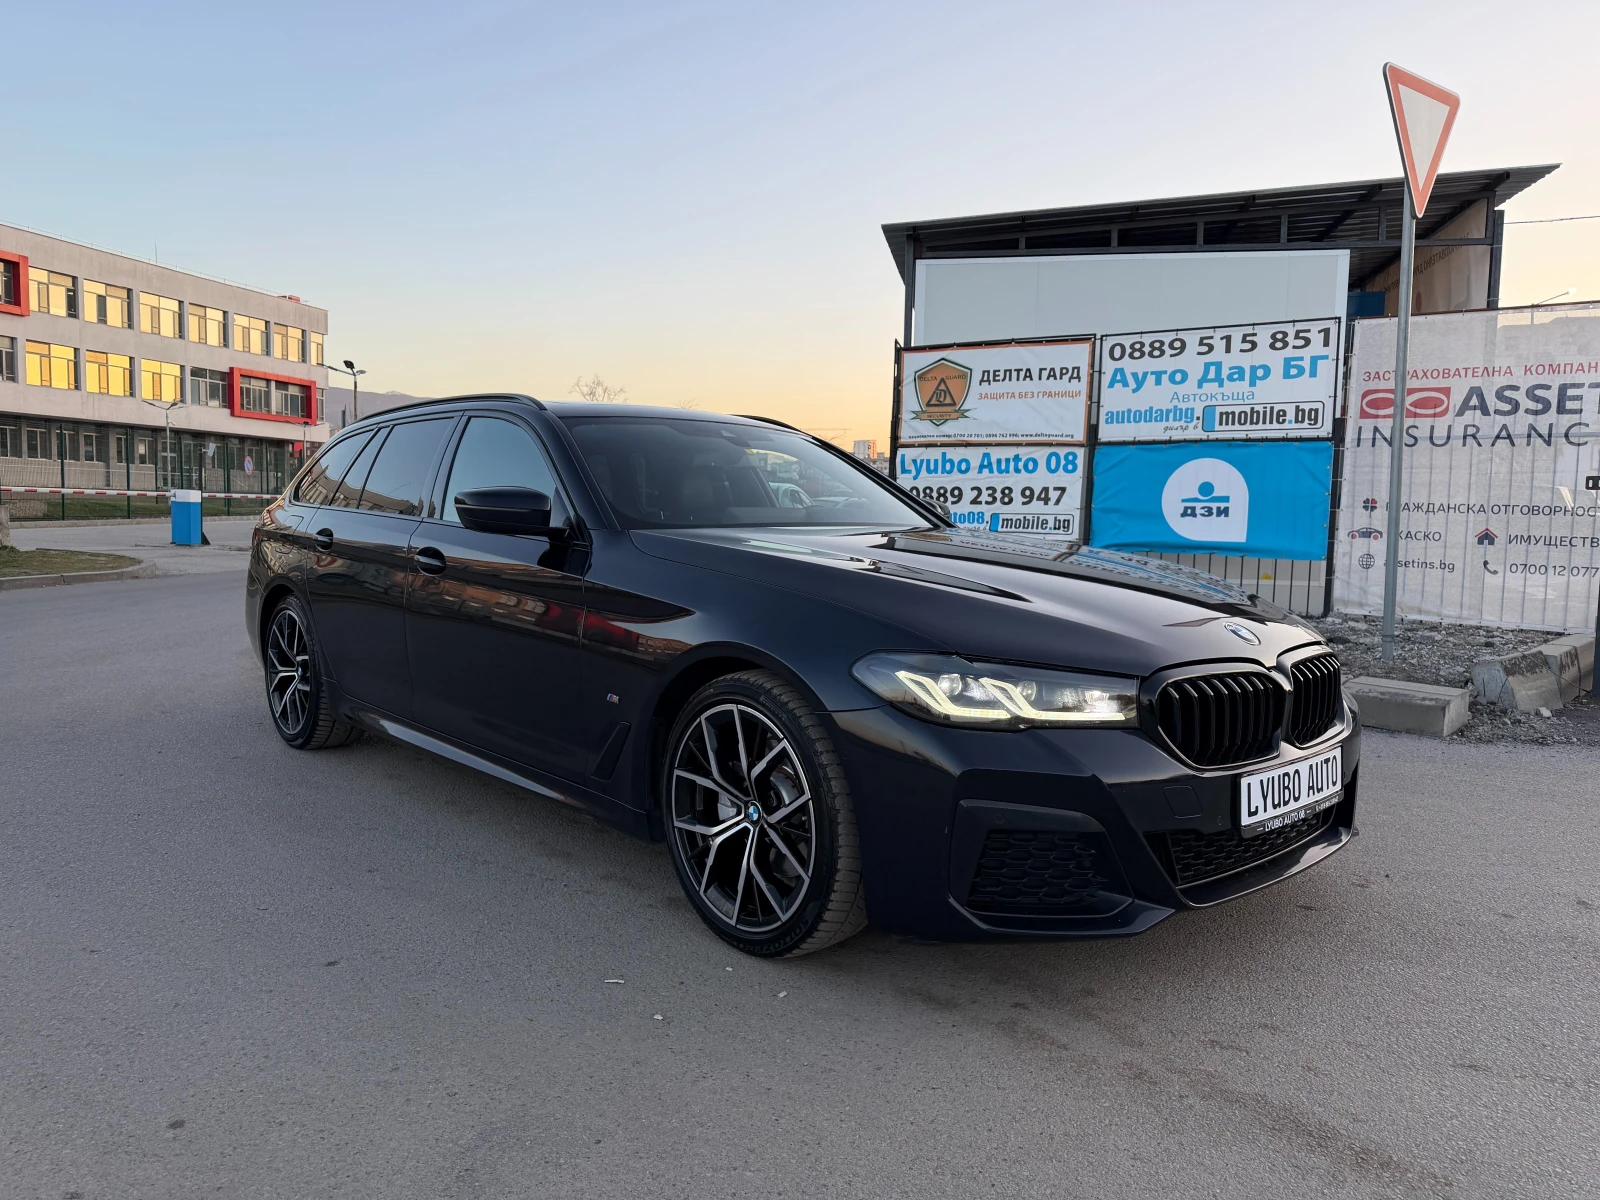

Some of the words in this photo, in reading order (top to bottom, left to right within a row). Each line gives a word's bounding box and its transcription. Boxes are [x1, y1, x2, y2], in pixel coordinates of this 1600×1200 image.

[1108, 337, 1187, 361] 0889
[1196, 332, 1258, 356] 515
[1268, 327, 1331, 351] 851
[979, 368, 1034, 386] ДЕЛТА
[1038, 366, 1082, 383] ГАРД
[1107, 367, 1189, 394] Ауто
[1197, 361, 1271, 389] Дар
[1282, 355, 1330, 380] БГ
[1362, 365, 1513, 382] ЗАСАХОВАТЕЛНА
[978, 392, 1016, 402] ЗАЩИТА
[1018, 391, 1035, 400] БЕЗ
[1036, 390, 1082, 400] ГРАНИЦИ
[1169, 390, 1255, 404] Автокъща
[1218, 406, 1320, 427] mobile.bg
[900, 452, 971, 480] Lyubo
[977, 452, 1038, 474] Auto
[1045, 451, 1078, 474] 08
[969, 486, 1014, 505] 238
[1020, 486, 1067, 506] 947
[1180, 505, 1230, 518] ДЗИ
[1001, 516, 1070, 532] mobile.bg
[1508, 534, 1600, 549] ИМУЩЕСТВ
[1509, 562, 1548, 575] 0700
[1552, 564, 1566, 576] 12
[1570, 566, 1600, 578] 077
[1247, 768, 1301, 818] LYUBO
[1307, 755, 1338, 798] AUTO
[1265, 819, 1284, 831] LYUBO
[1284, 813, 1299, 825] AUTO
